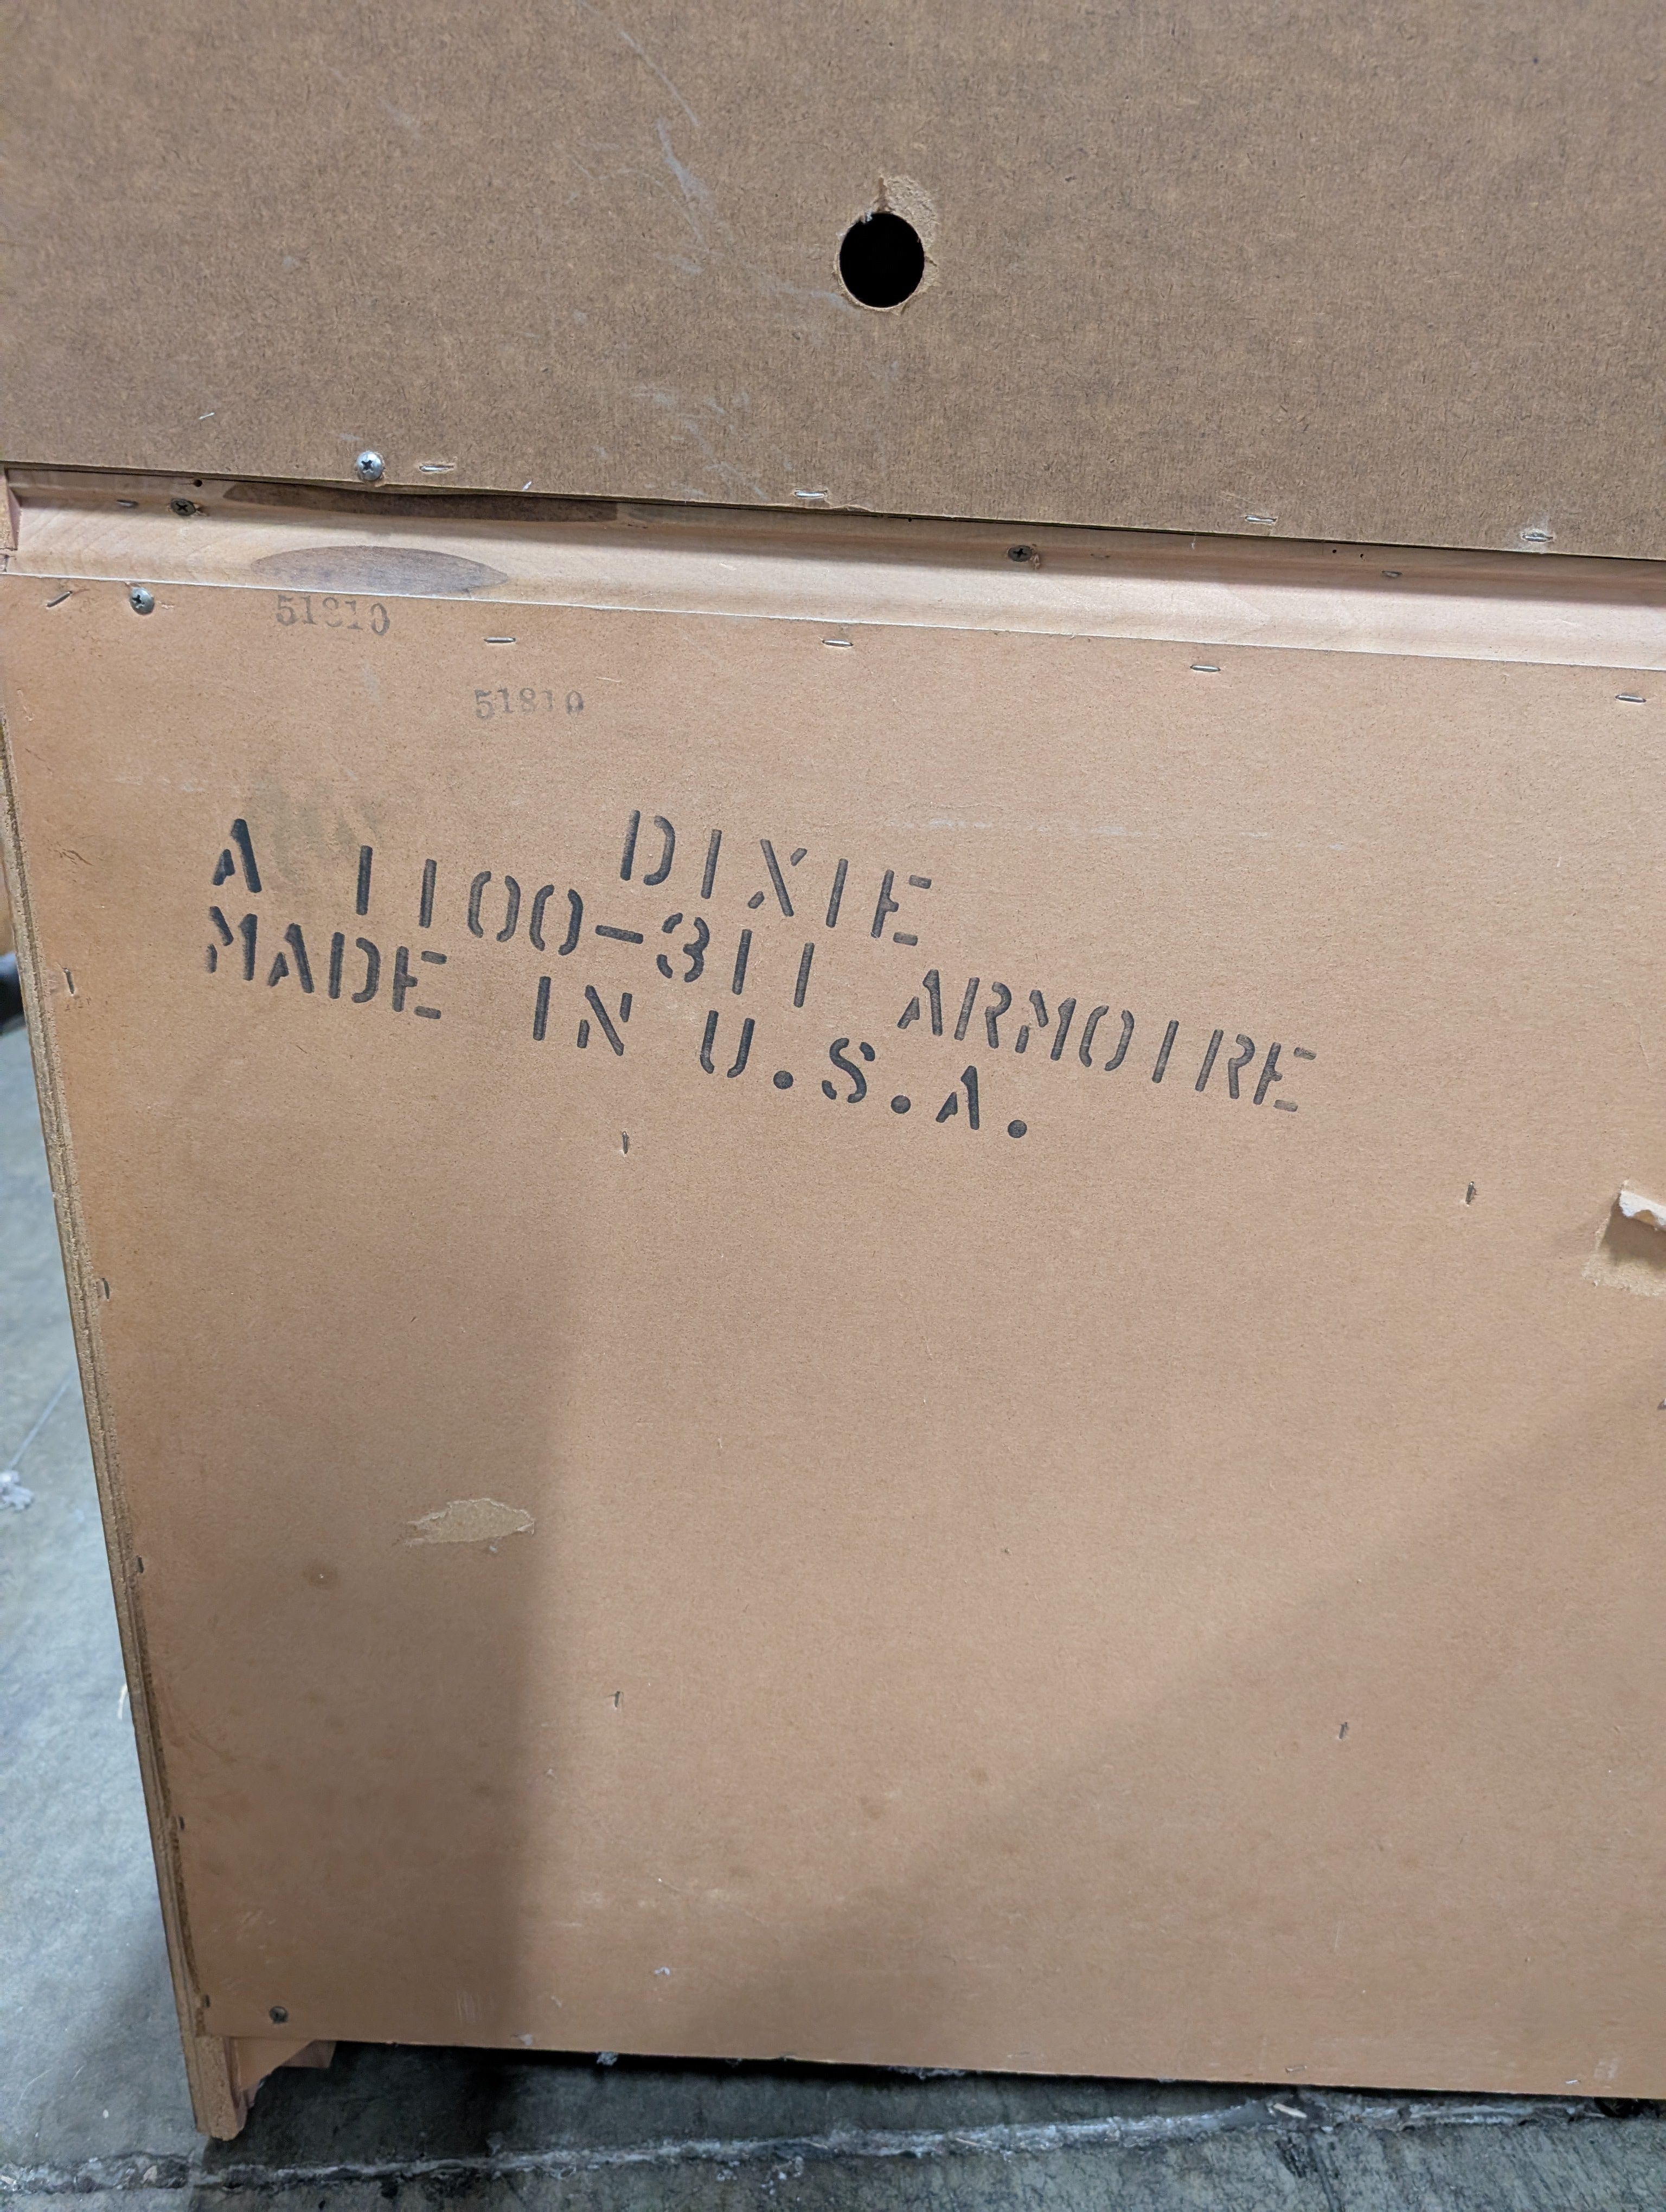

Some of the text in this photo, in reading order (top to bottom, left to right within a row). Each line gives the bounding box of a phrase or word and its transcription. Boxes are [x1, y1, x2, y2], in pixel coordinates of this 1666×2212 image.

[474, 687, 585, 720] 51810
[212, 818, 1316, 1113] A 1100-311 ARMOIRE
[619, 810, 932, 947] DIXIE
[207, 906, 1028, 1139] MADE IN U.S.A.
